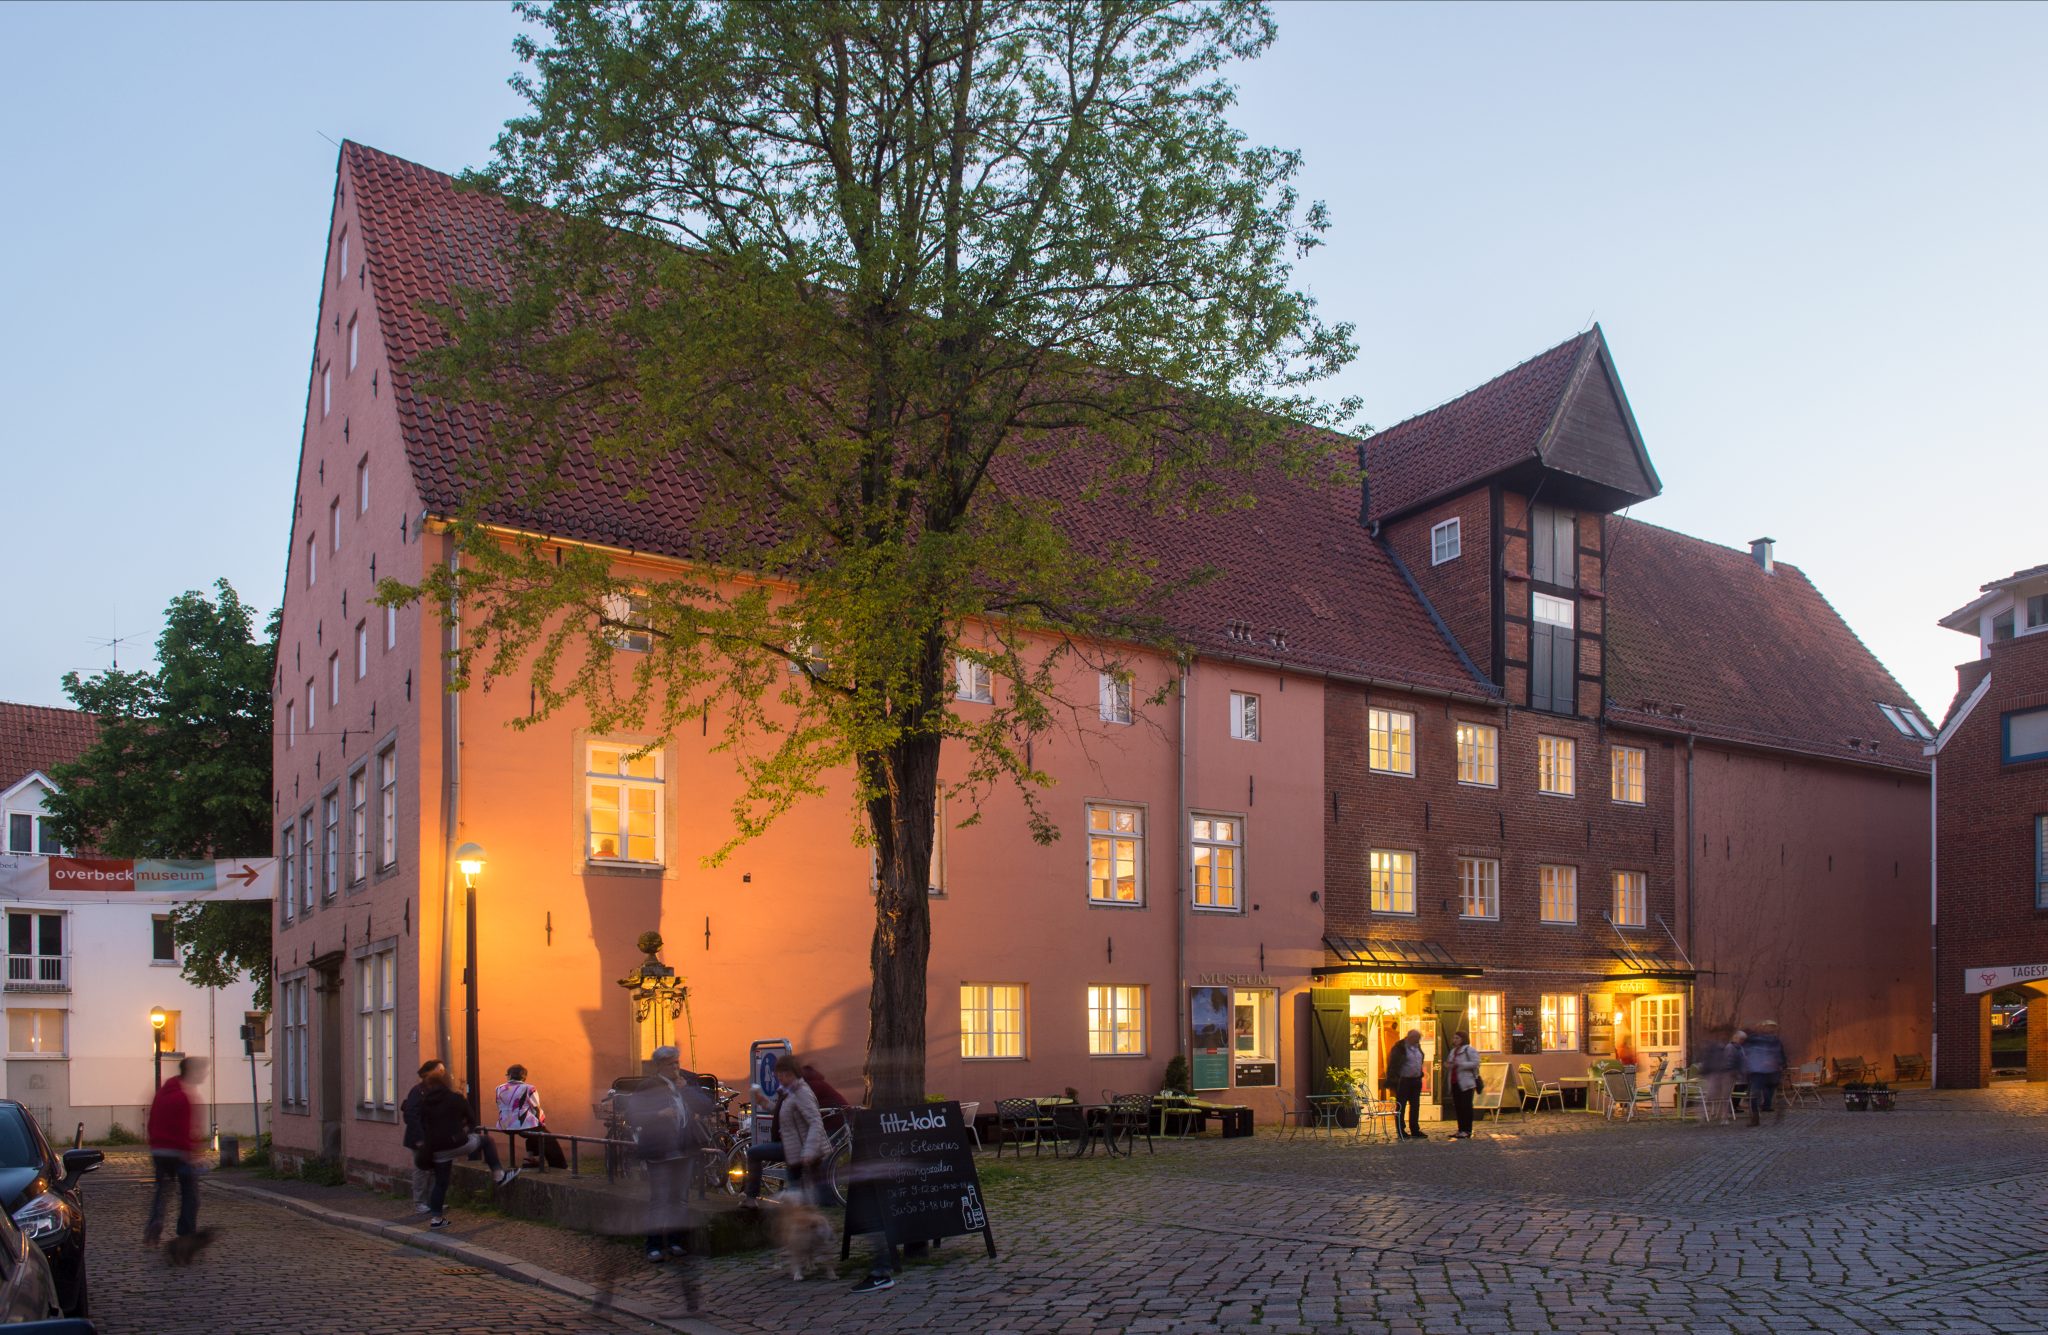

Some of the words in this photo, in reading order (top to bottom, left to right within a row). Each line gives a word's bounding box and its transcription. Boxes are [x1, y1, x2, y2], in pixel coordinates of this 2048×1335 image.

[2012, 965, 2048, 977] TAGESP
[1200, 972, 1273, 985] MUSEUM
[1364, 972, 1406, 987] KITO
[880, 1109, 946, 1133] fritz-kola
